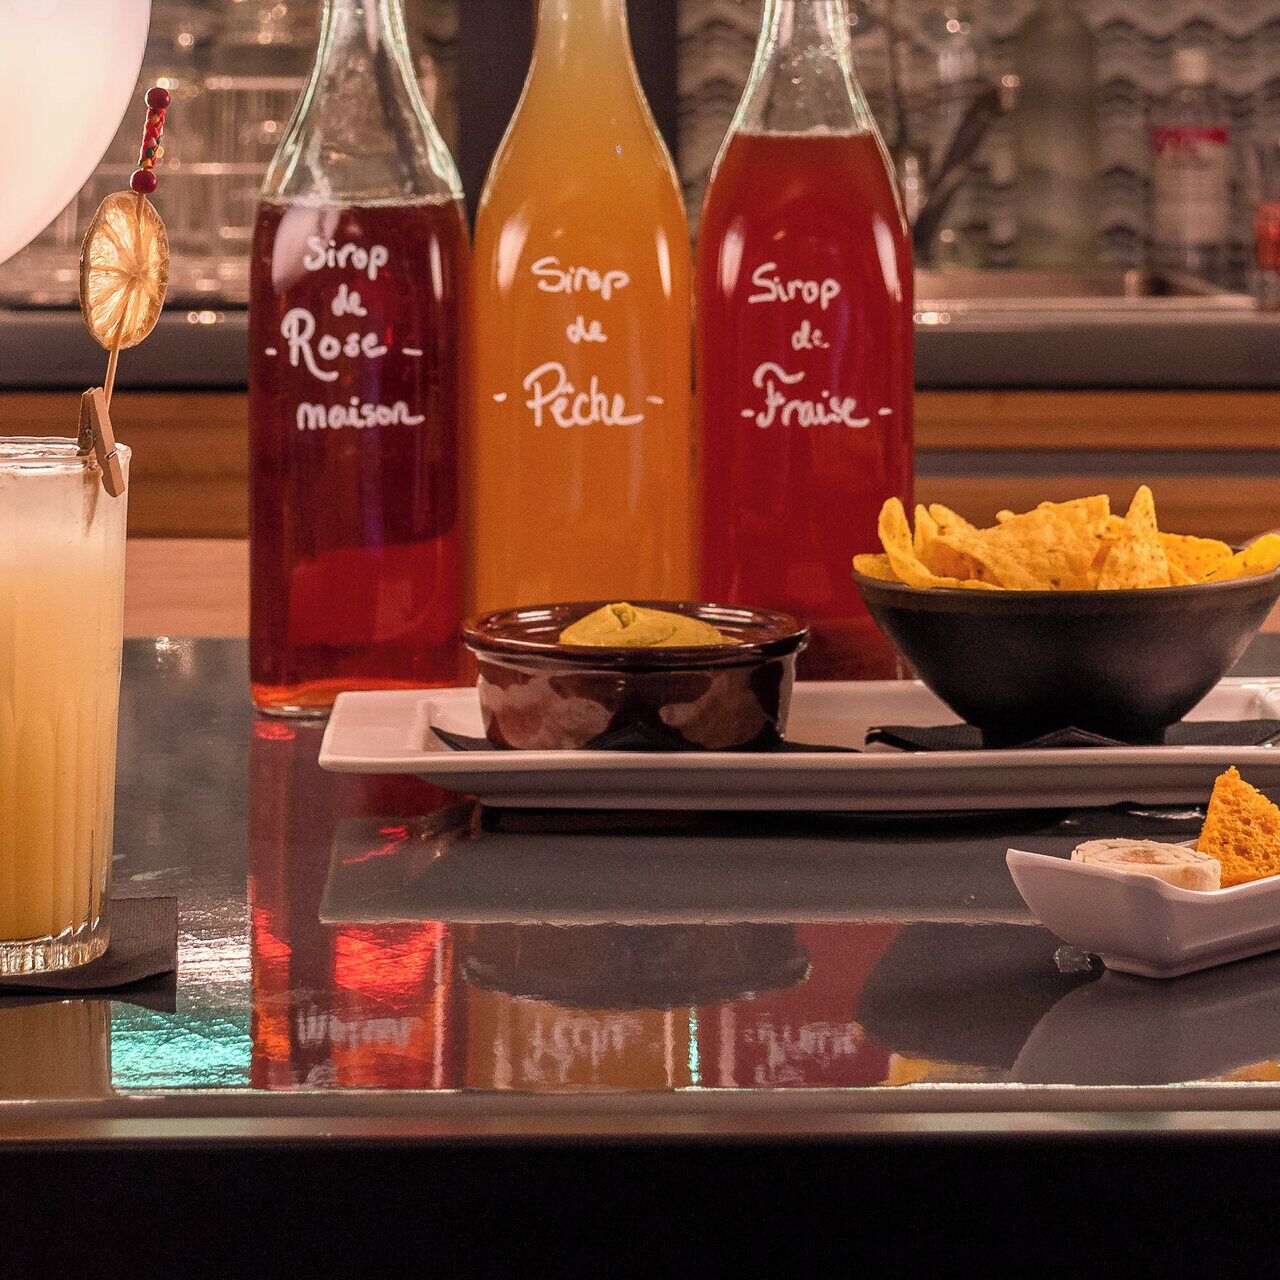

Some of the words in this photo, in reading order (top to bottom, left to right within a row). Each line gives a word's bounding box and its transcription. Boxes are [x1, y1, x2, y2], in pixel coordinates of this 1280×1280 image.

[303, 234, 389, 281] Sirop
[531, 255, 631, 301] Sirop
[331, 282, 368, 317] de
[748, 261, 842, 311] Sirop
[280, 307, 388, 382] Rose
[566, 313, 608, 344] de
[791, 319, 830, 351] de
[296, 395, 425, 431] maison
[522, 361, 645, 428] Pêche
[752, 361, 871, 429] Fraise
